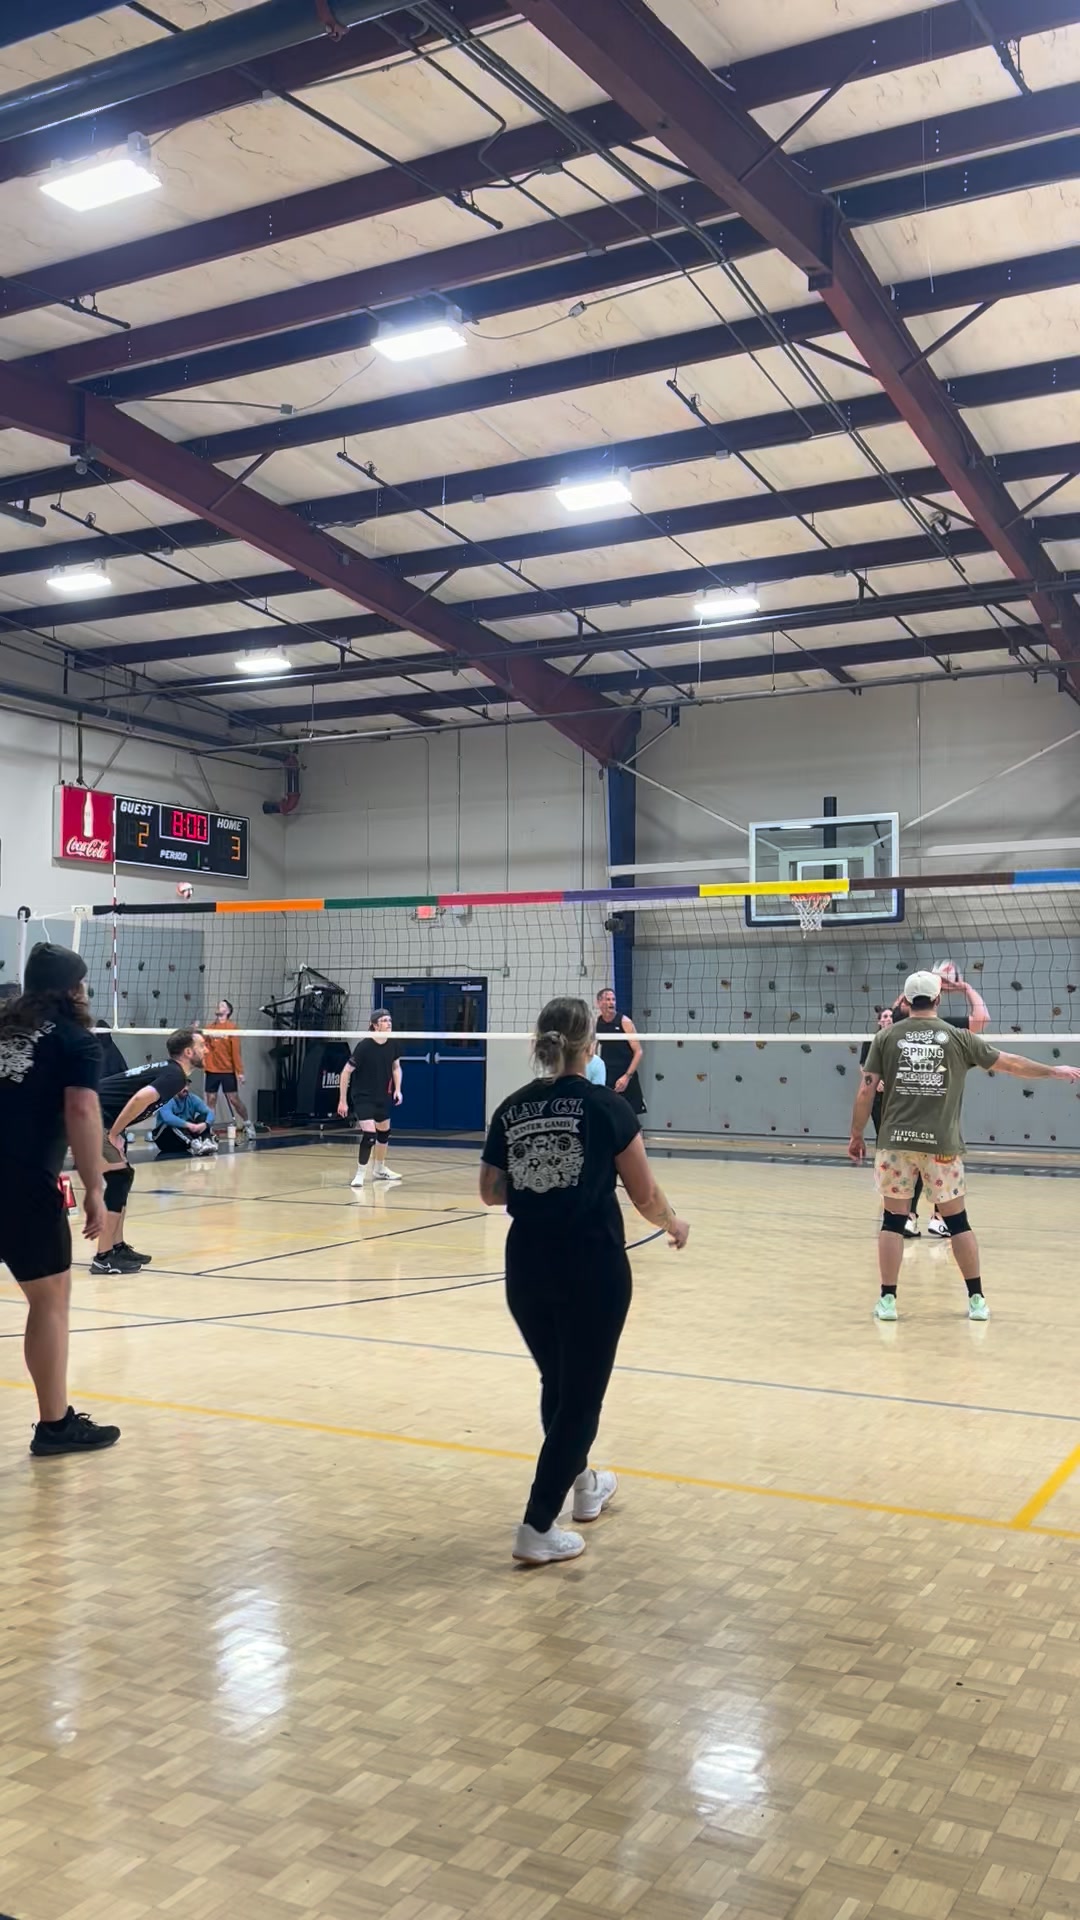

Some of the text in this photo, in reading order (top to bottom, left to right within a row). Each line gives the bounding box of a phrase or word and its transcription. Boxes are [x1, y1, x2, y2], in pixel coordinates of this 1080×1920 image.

[120, 801, 153, 817] GUEST
[172, 810, 208, 841] 8:00
[217, 817, 242, 831] HOME
[136, 821, 150, 848] 2
[159, 849, 188, 862] PERIOD
[230, 835, 241, 860] 3
[902, 1046, 944, 1059] SPRING
[501, 1097, 584, 1130] PLAY CSL
